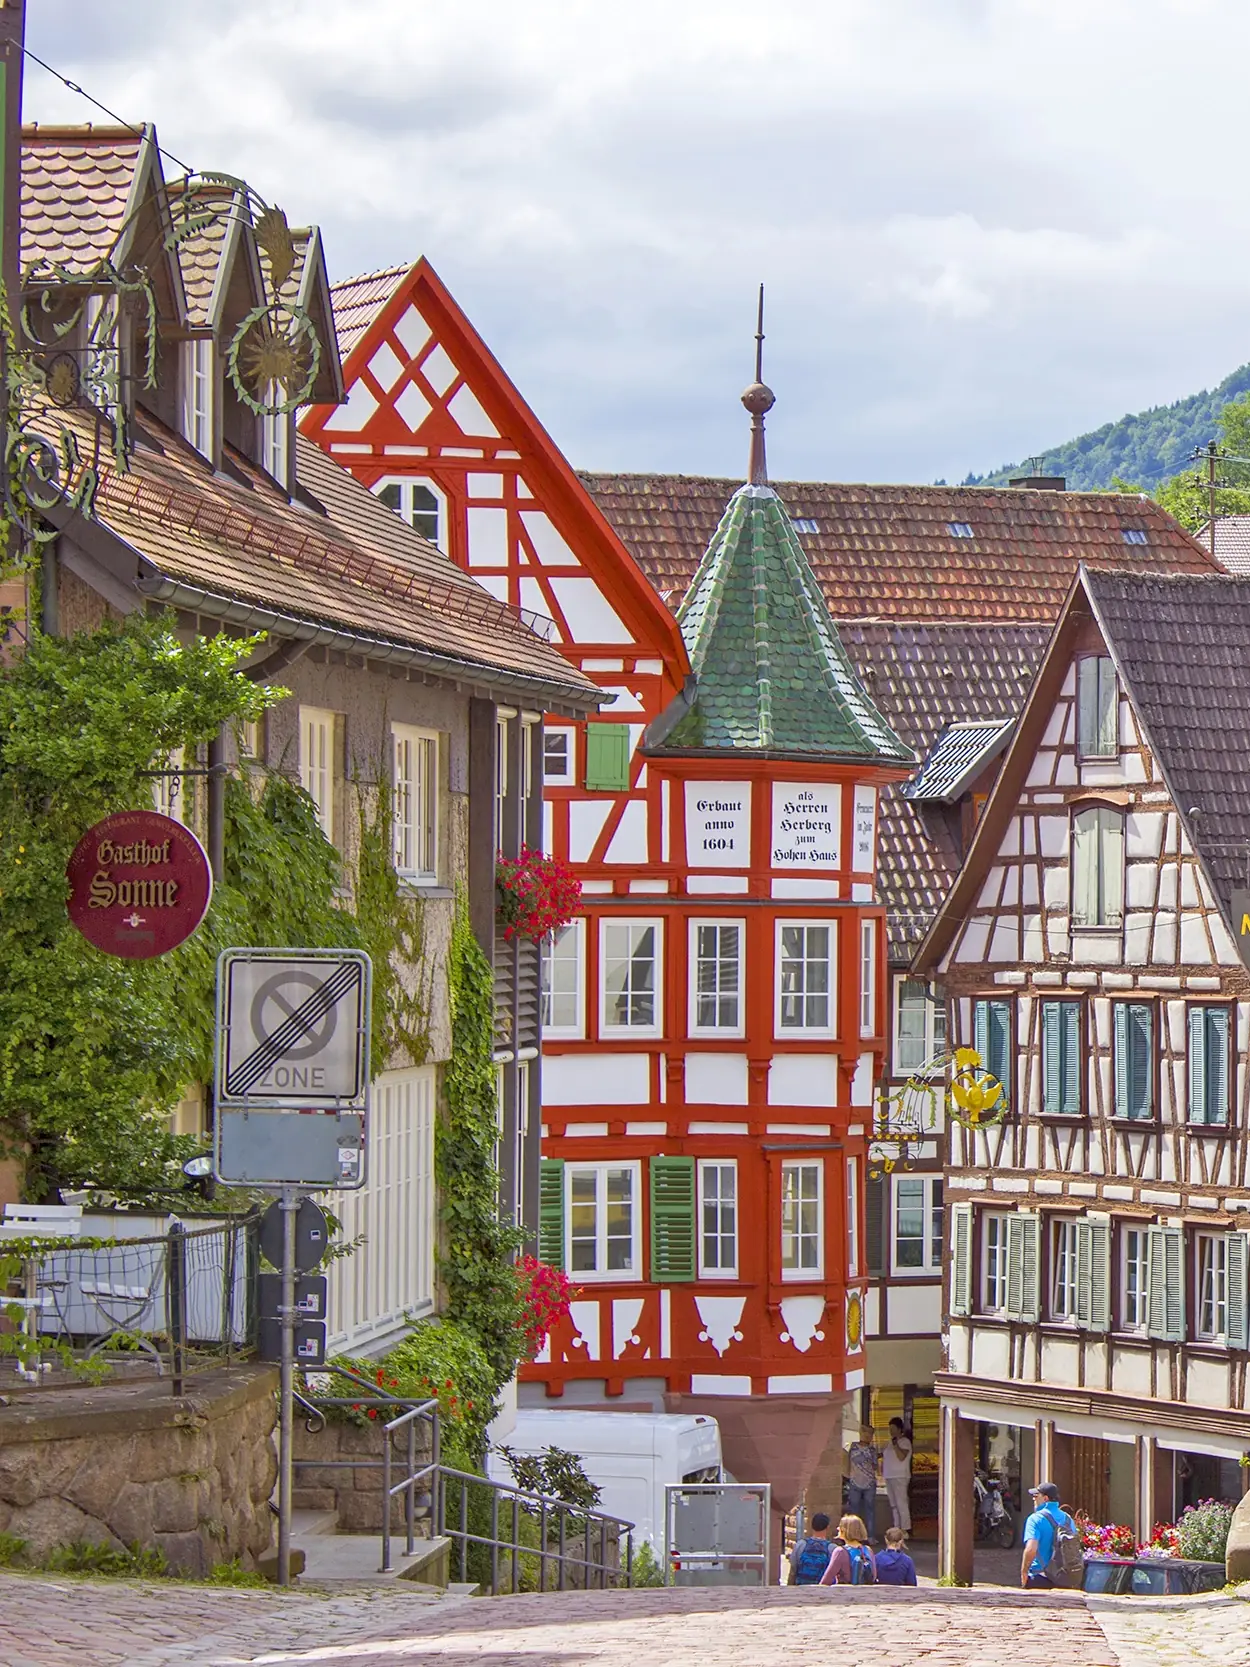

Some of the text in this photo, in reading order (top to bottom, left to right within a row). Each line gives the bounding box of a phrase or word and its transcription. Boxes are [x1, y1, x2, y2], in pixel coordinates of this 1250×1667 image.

[797, 790, 814, 801] als
[696, 799, 742, 812] Erbaut
[783, 802, 828, 814] Herren
[704, 819, 735, 830] anno
[780, 819, 832, 834] Herberg
[702, 838, 735, 850] 1604
[794, 835, 816, 846] zum
[96, 839, 172, 868] Gasthof
[773, 848, 838, 863] Hohen Haus
[87, 870, 179, 909] Sonne
[259, 1067, 325, 1089] ZONE
